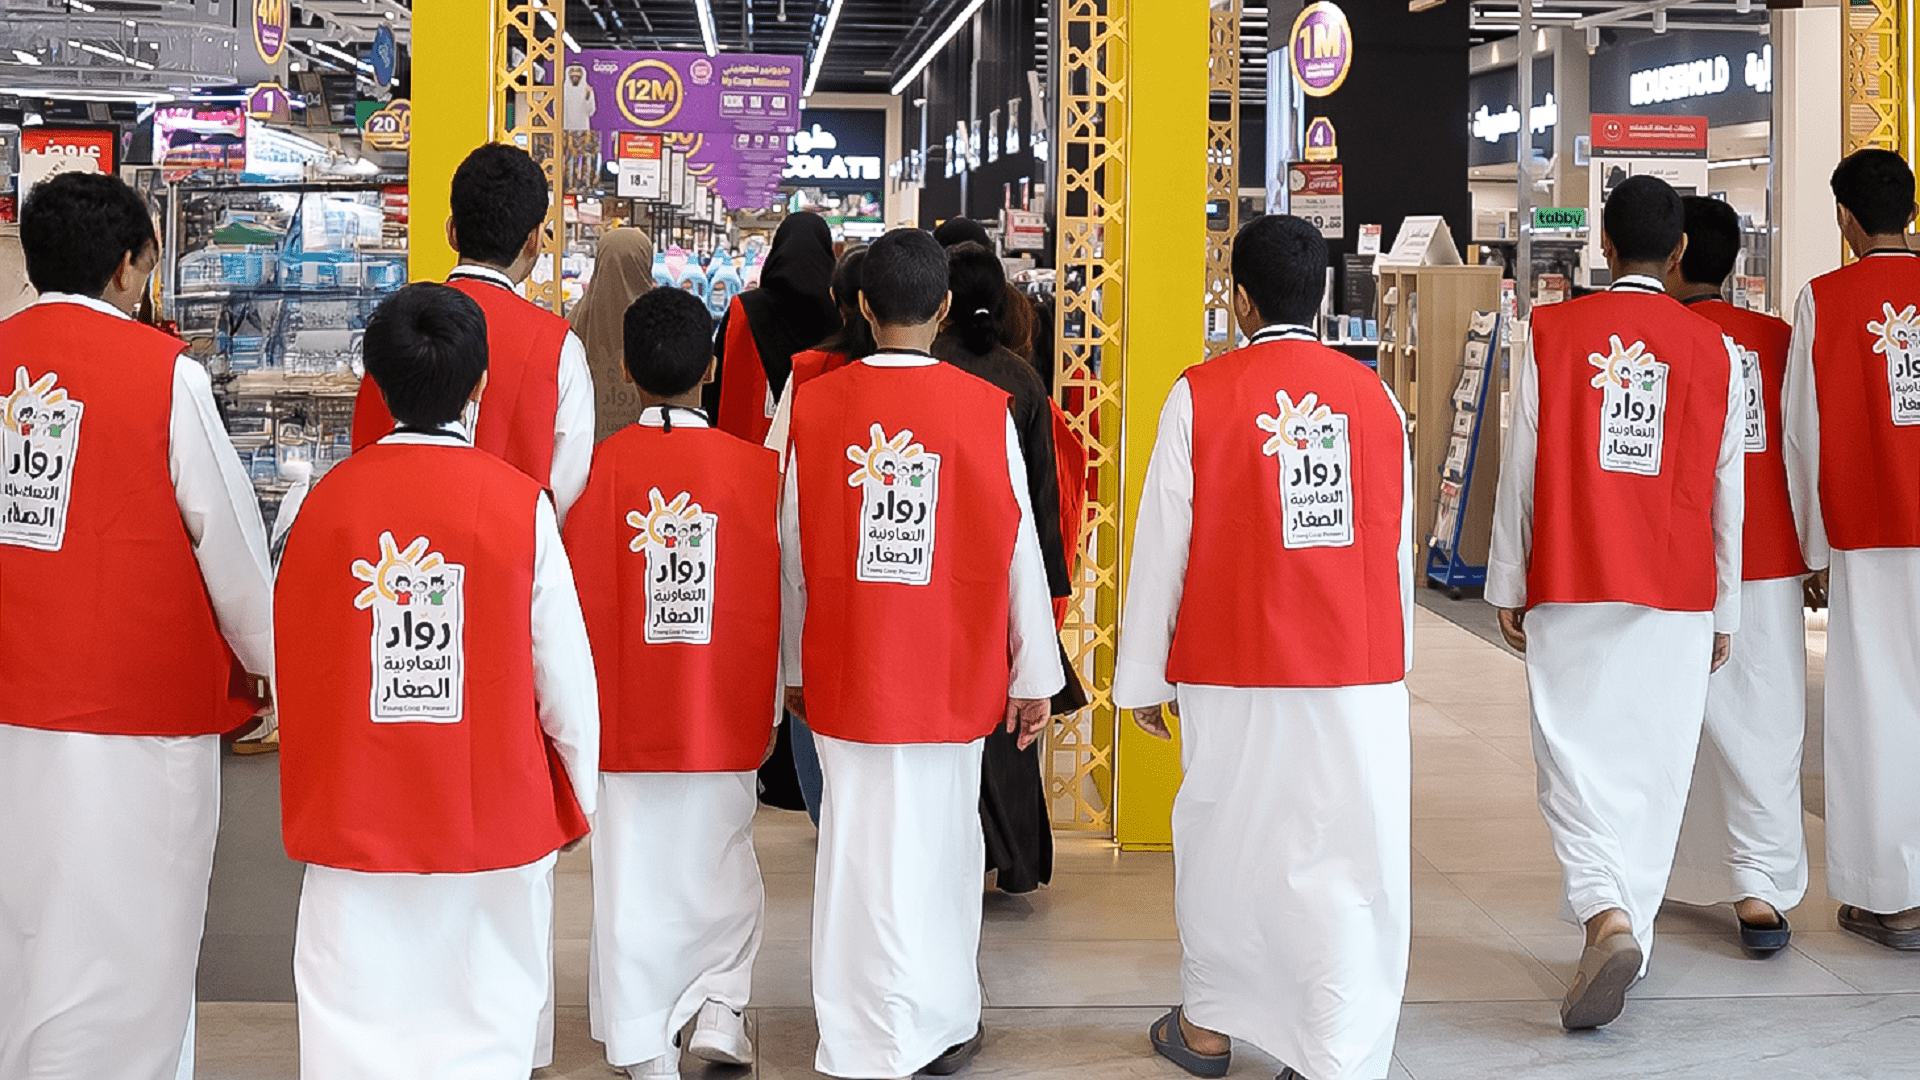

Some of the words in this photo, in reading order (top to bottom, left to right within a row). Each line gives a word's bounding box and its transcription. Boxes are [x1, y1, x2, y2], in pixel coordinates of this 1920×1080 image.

[1299, 23, 1341, 60] 1M
[625, 79, 674, 102] 12M
[1629, 55, 1730, 107] HOUSEHOLD
[262, 91, 275, 111] 1
[372, 116, 396, 133] 20
[1313, 125, 1324, 146] 4
[1308, 180, 1338, 190] OFFER
[1538, 210, 1582, 228] tabby
[1607, 439, 1653, 458] الصغار
[1290, 490, 1343, 507] التعاونية
[1292, 508, 1343, 531] الصغار
[869, 526, 925, 543] التعاونية
[867, 544, 923, 565] الصغار
[653, 588, 706, 604] التعاونية
[653, 606, 704, 628] الصغار
[383, 655, 451, 673] التعاونية
[382, 677, 450, 703] الصغار
